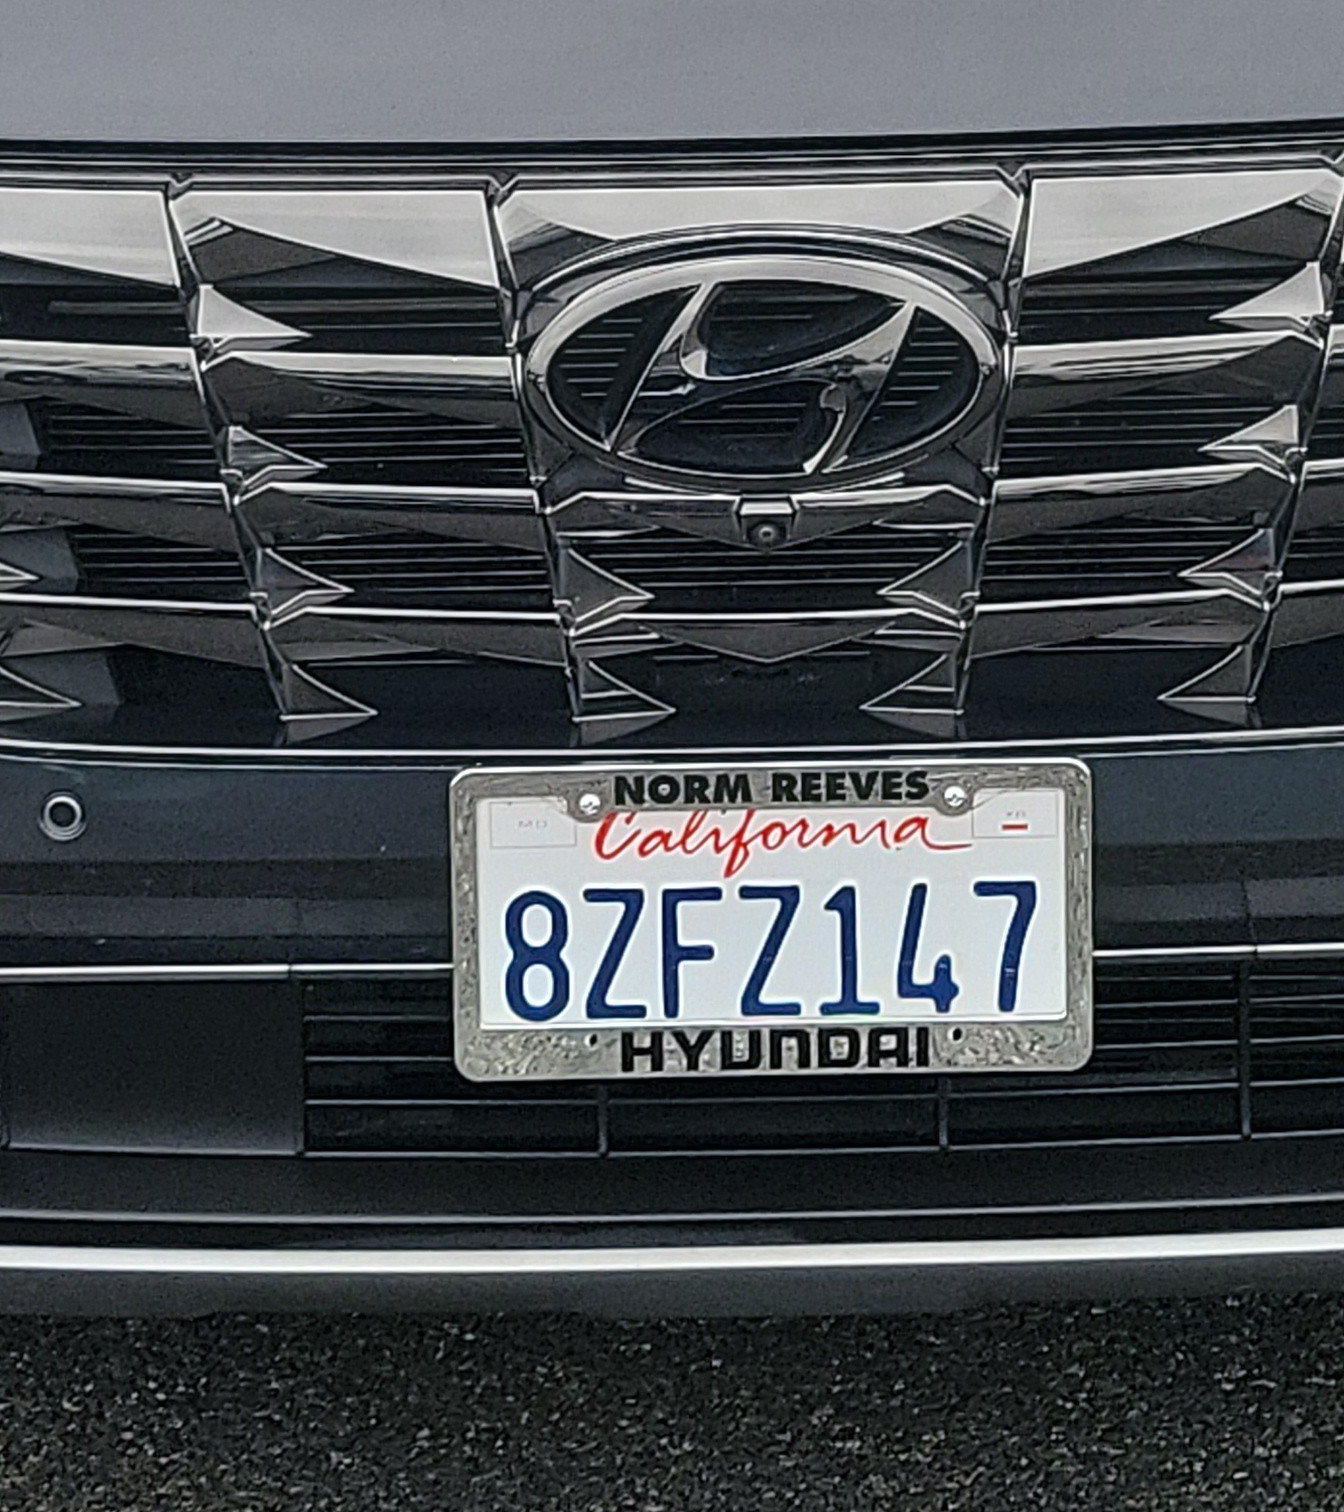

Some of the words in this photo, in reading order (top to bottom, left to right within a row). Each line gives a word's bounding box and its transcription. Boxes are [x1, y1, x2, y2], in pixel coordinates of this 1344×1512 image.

[613, 772, 753, 806] NORM
[770, 769, 931, 803] REEVES
[595, 808, 973, 879] California
[504, 879, 1038, 1022] 8ZFZ147
[620, 1026, 931, 1073] HYUNDAI
